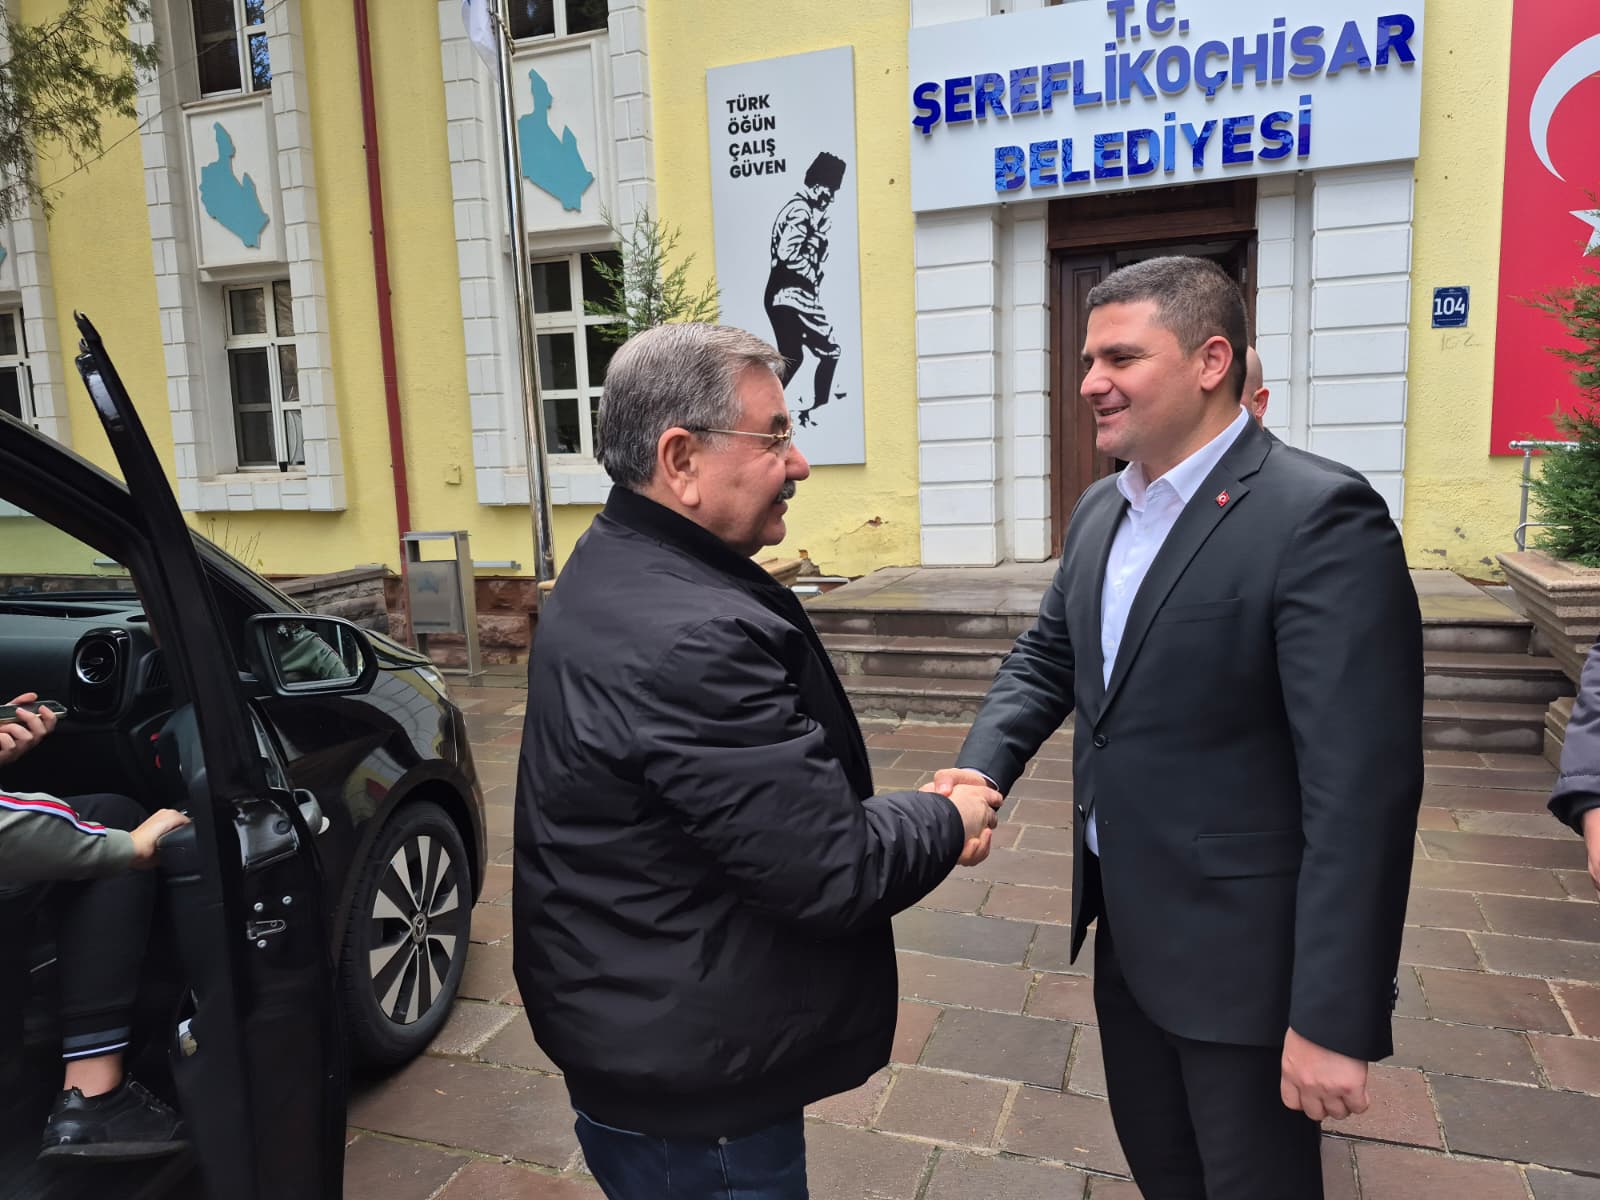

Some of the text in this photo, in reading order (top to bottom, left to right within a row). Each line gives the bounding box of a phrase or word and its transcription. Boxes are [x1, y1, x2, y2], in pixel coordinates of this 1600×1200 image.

[1106, 0, 1190, 39] T.C.
[912, 14, 1416, 135] ŞEREFLİKOÇHİSAR
[726, 94, 770, 113] TÜRK
[728, 114, 776, 135] ÖĞÜN
[729, 138, 776, 161] ÇALIŞ
[994, 94, 1312, 192] BELEDİYESİ
[730, 159, 786, 178] GÜVEN
[1434, 297, 1466, 316] 104
